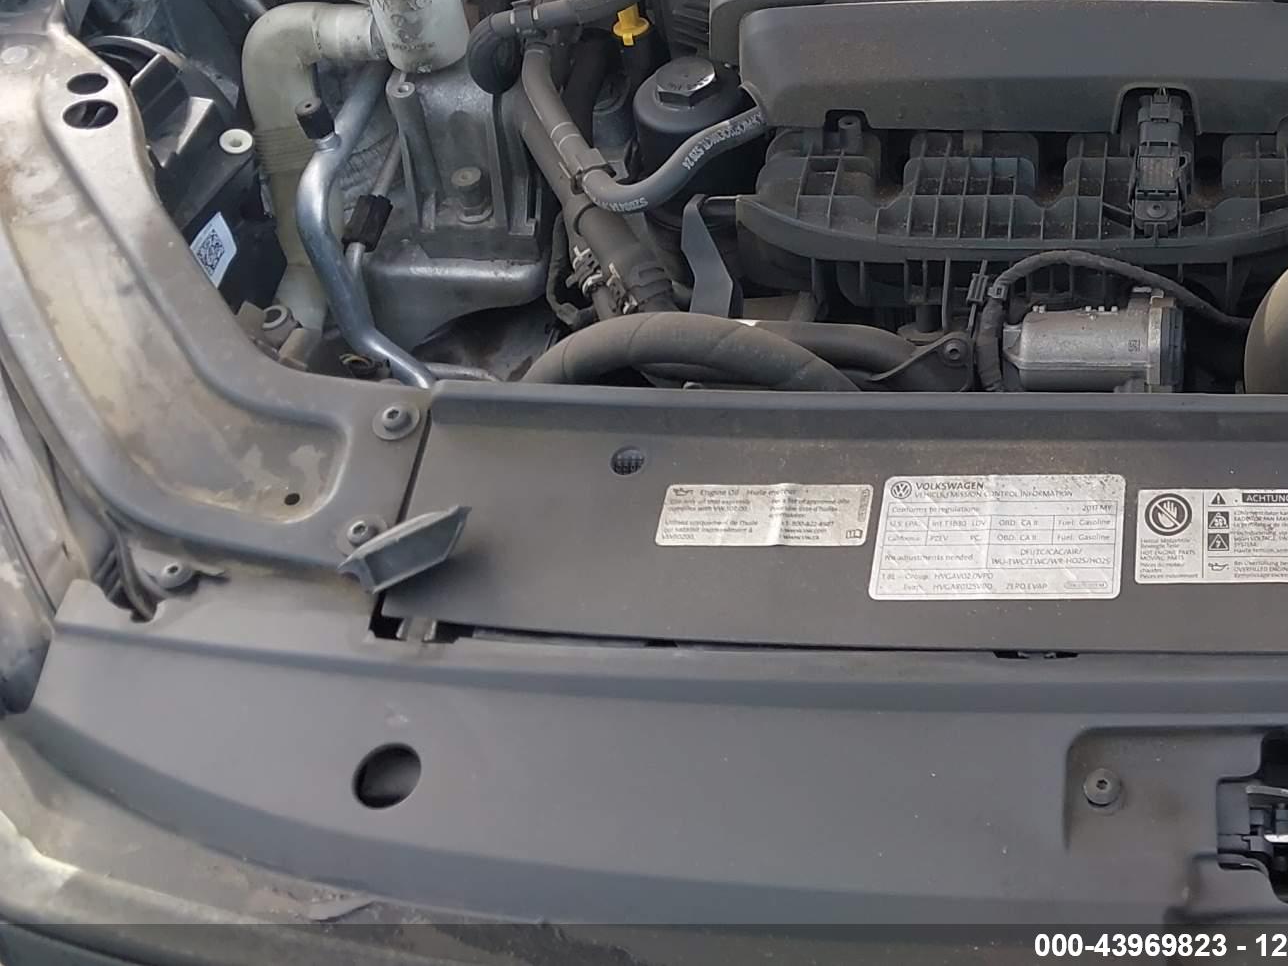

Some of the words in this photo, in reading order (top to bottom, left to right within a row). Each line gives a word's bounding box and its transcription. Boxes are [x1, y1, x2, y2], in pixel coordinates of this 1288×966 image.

[915, 482, 984, 490] VOLKSWAGEN
[1020, 489, 1072, 497] INFORMATION
[1078, 518, 1111, 526] Gasoline
